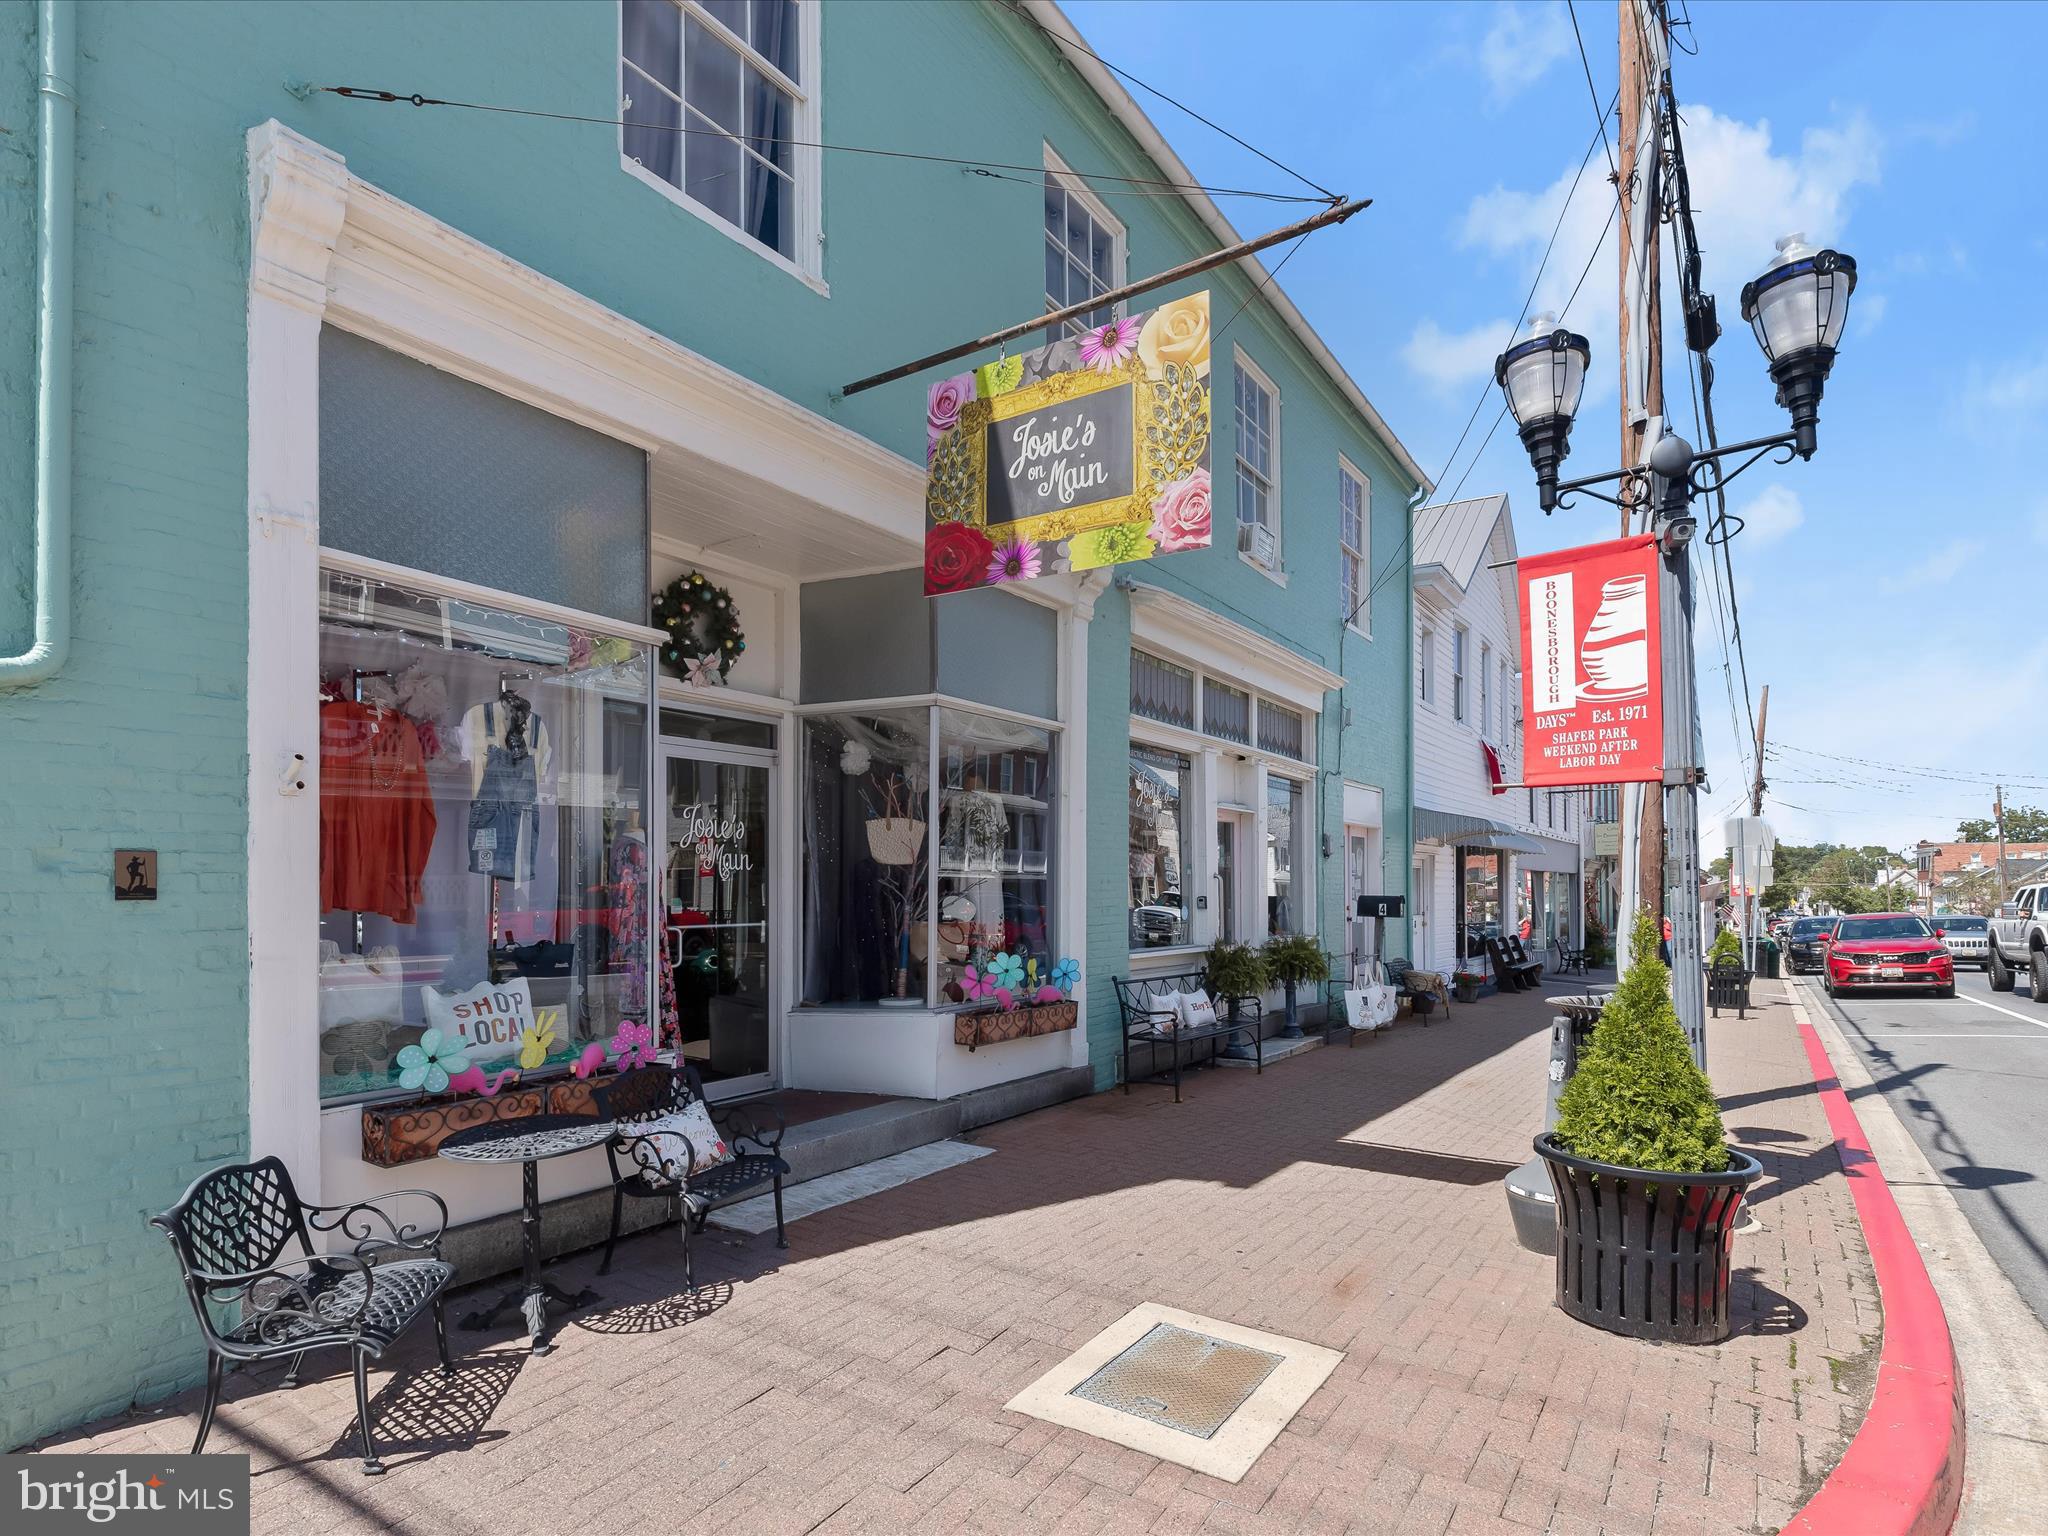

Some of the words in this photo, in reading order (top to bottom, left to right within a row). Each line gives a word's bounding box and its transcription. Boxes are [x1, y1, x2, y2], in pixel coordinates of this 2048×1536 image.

[1009, 413, 1097, 479] Josie's
[1028, 462, 1046, 481] on
[1037, 454, 1108, 504] Main
[1546, 581, 1559, 704] BOONESBOROUGH
[1592, 709, 1615, 723] Est.
[1619, 705, 1648, 721] 1971
[1544, 743, 1597, 758] WEEKEND
[1601, 739, 1638, 753] AFTER
[1552, 730, 1595, 744] SHAFER
[1599, 727, 1628, 740] PARK
[1559, 755, 1596, 769] LABOR
[1600, 754, 1621, 766] DAY
[680, 804, 745, 848] Josie's
[695, 843, 708, 854] on
[703, 843, 753, 881] Main
[1380, 904, 1387, 915] 4
[453, 992, 523, 1019] SHOP
